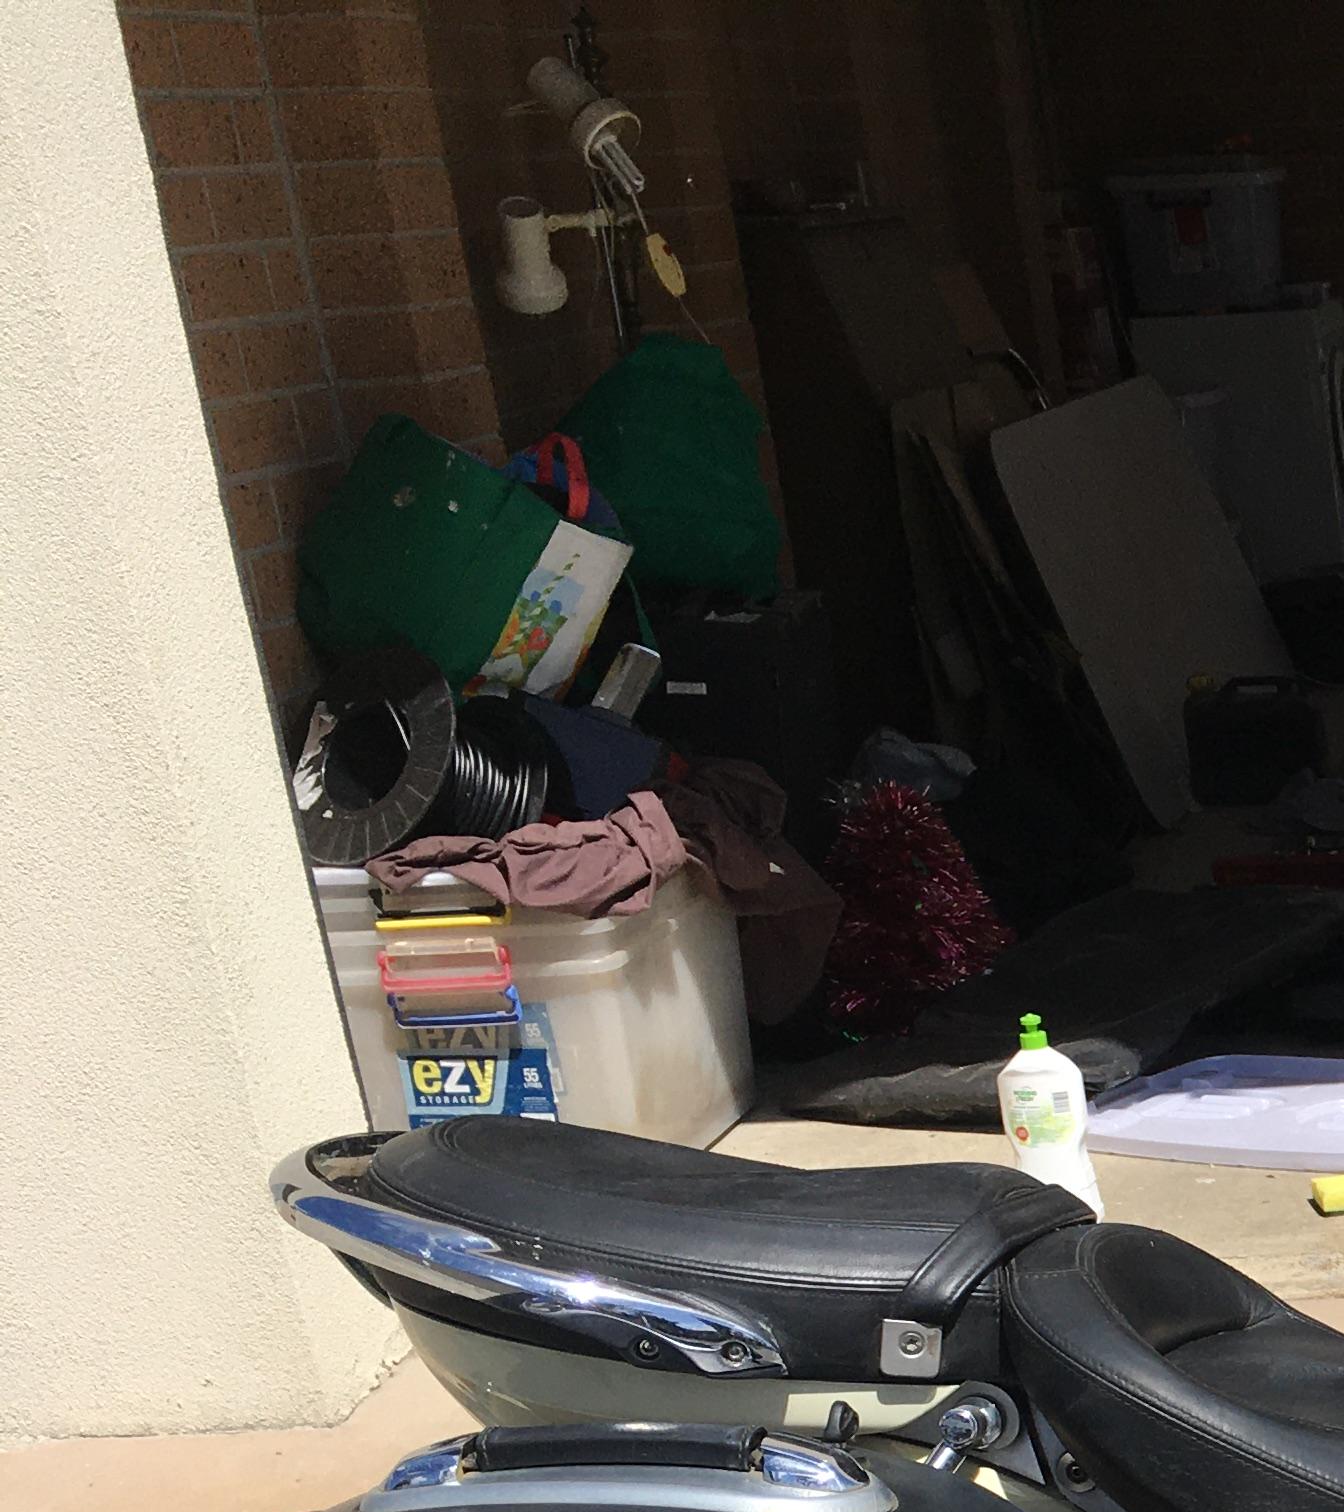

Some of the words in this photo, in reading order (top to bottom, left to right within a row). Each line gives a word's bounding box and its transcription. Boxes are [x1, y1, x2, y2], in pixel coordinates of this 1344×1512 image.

[412, 1058, 496, 1105] ezy
[523, 1067, 540, 1083] 55
[420, 1095, 475, 1105] STORAGE
